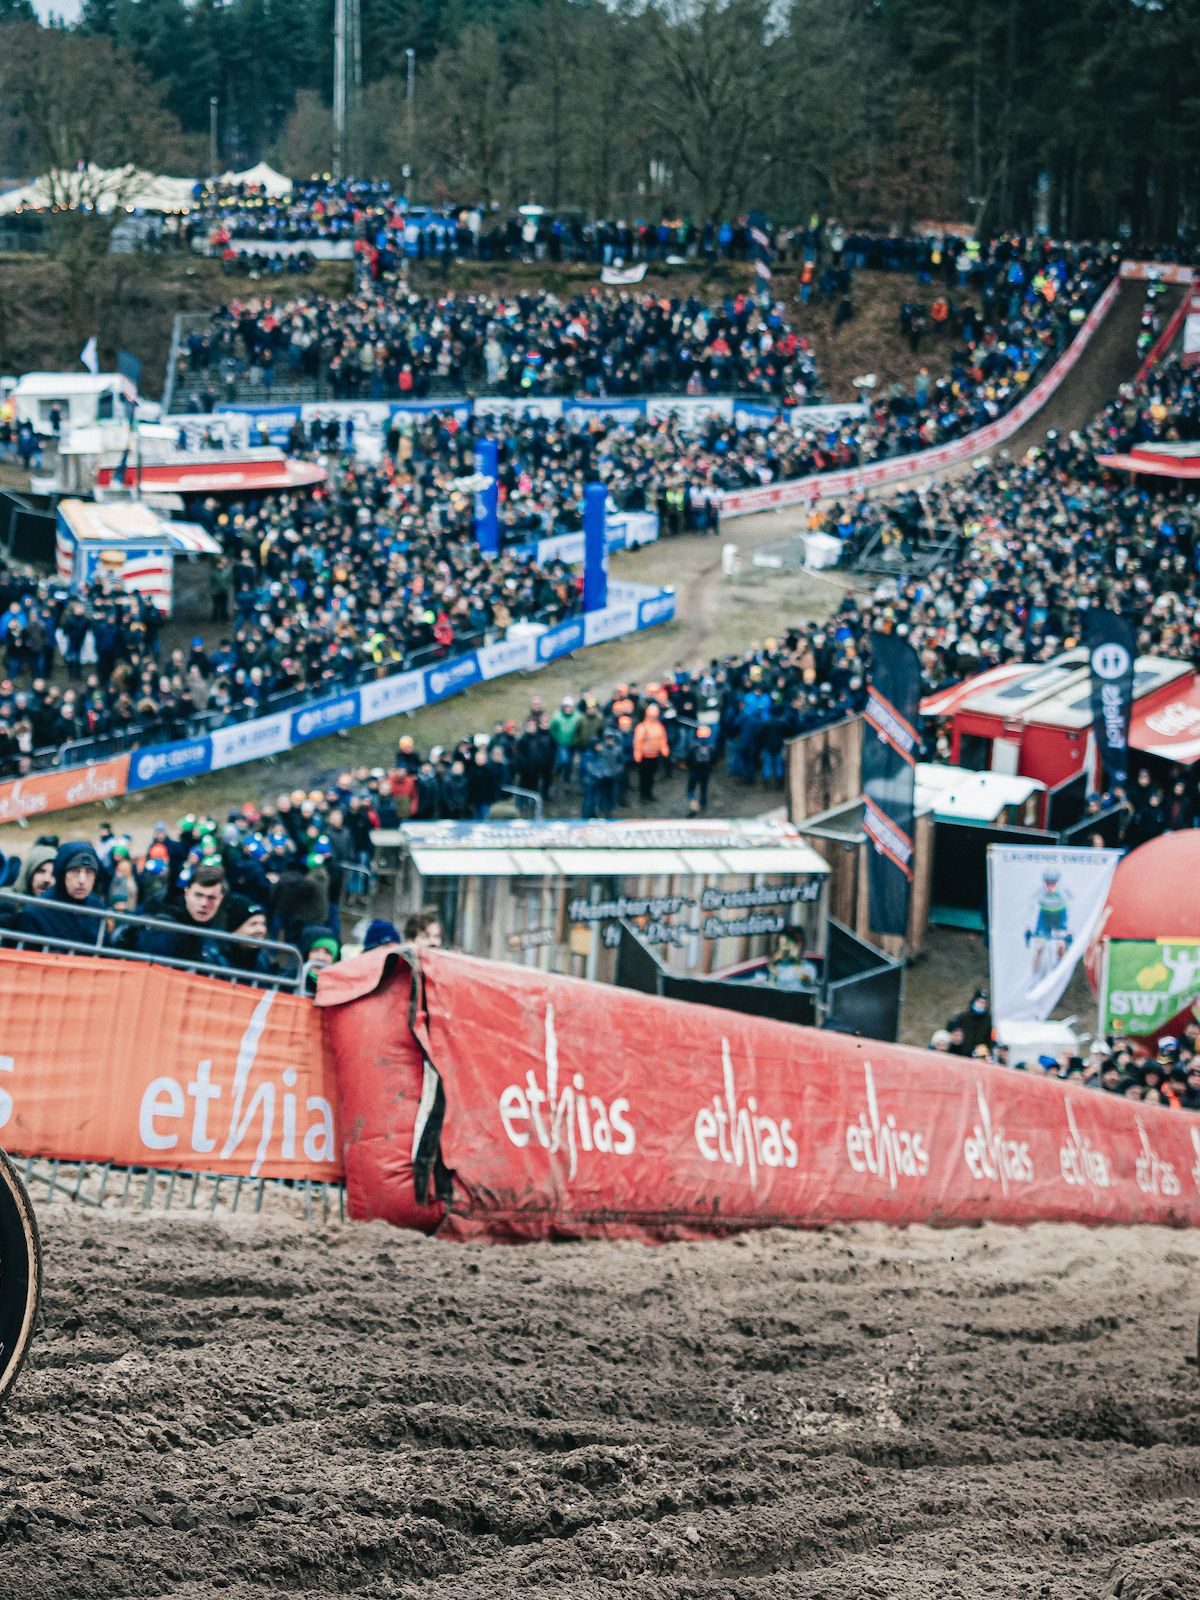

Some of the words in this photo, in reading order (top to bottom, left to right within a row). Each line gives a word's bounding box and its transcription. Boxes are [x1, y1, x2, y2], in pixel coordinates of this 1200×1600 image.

[139, 987, 336, 1178] ethia
[499, 1002, 637, 1184] ethias
[694, 1036, 799, 1190] ethias
[846, 1060, 930, 1191] ethias
